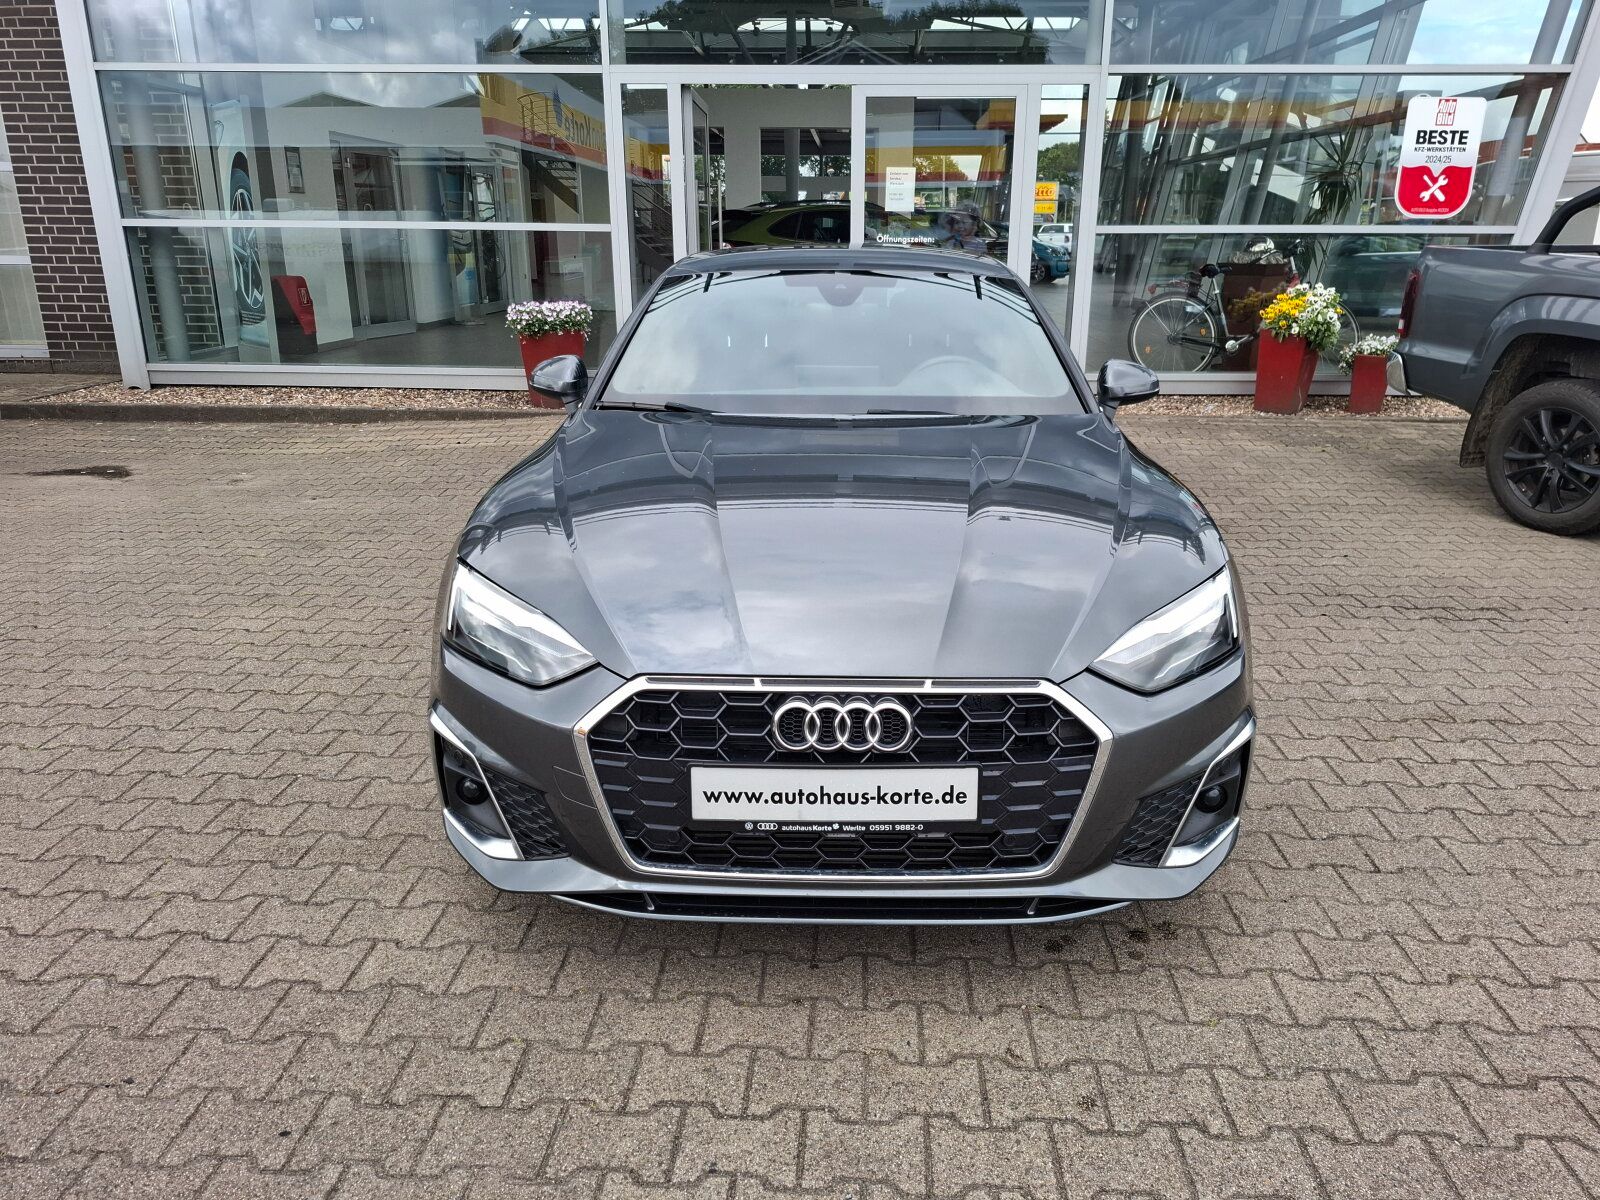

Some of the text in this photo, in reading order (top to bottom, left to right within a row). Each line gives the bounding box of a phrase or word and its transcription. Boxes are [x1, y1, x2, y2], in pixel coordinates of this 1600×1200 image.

[1415, 129, 1469, 145] BESTE
[1425, 155, 1452, 164] 2024/25
[876, 233, 935, 245] Öffnungszeiten:
[702, 785, 968, 805] www.autohaus-korte.de
